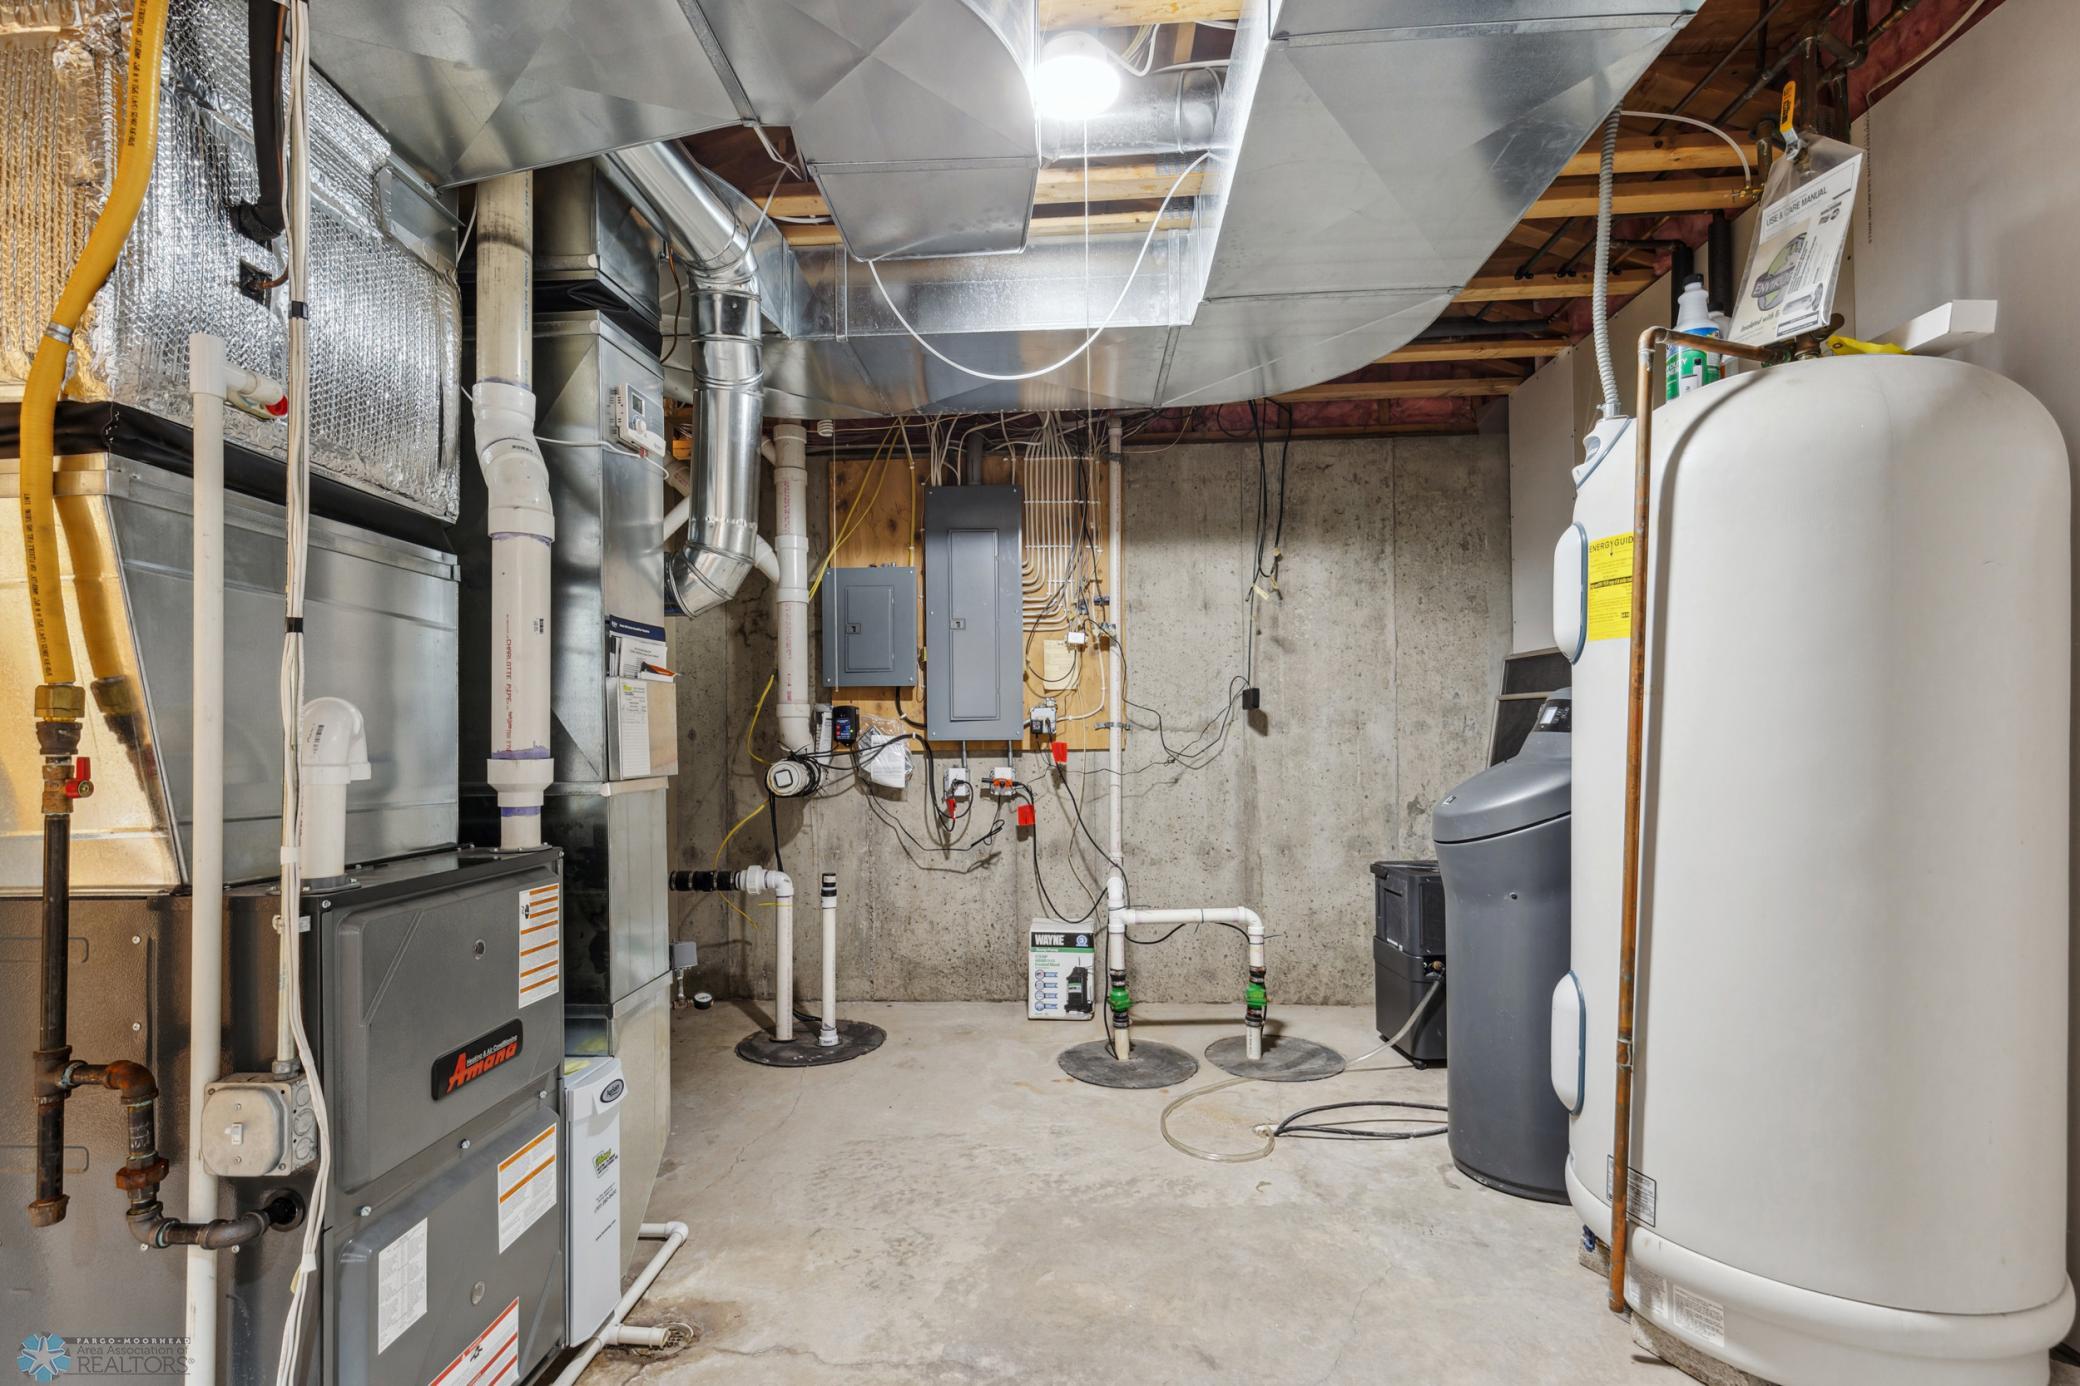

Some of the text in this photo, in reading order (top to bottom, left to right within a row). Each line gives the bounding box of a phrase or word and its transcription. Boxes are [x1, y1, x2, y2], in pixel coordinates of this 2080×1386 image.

[1766, 213, 1779, 227] USE
[1784, 202, 1801, 217] CARE
[1801, 186, 1827, 207] MANUAL
[1588, 535, 1634, 553] ENERGYGUID
[1035, 933, 1065, 946] WAYNE
[446, 1042, 518, 1093] Amana
